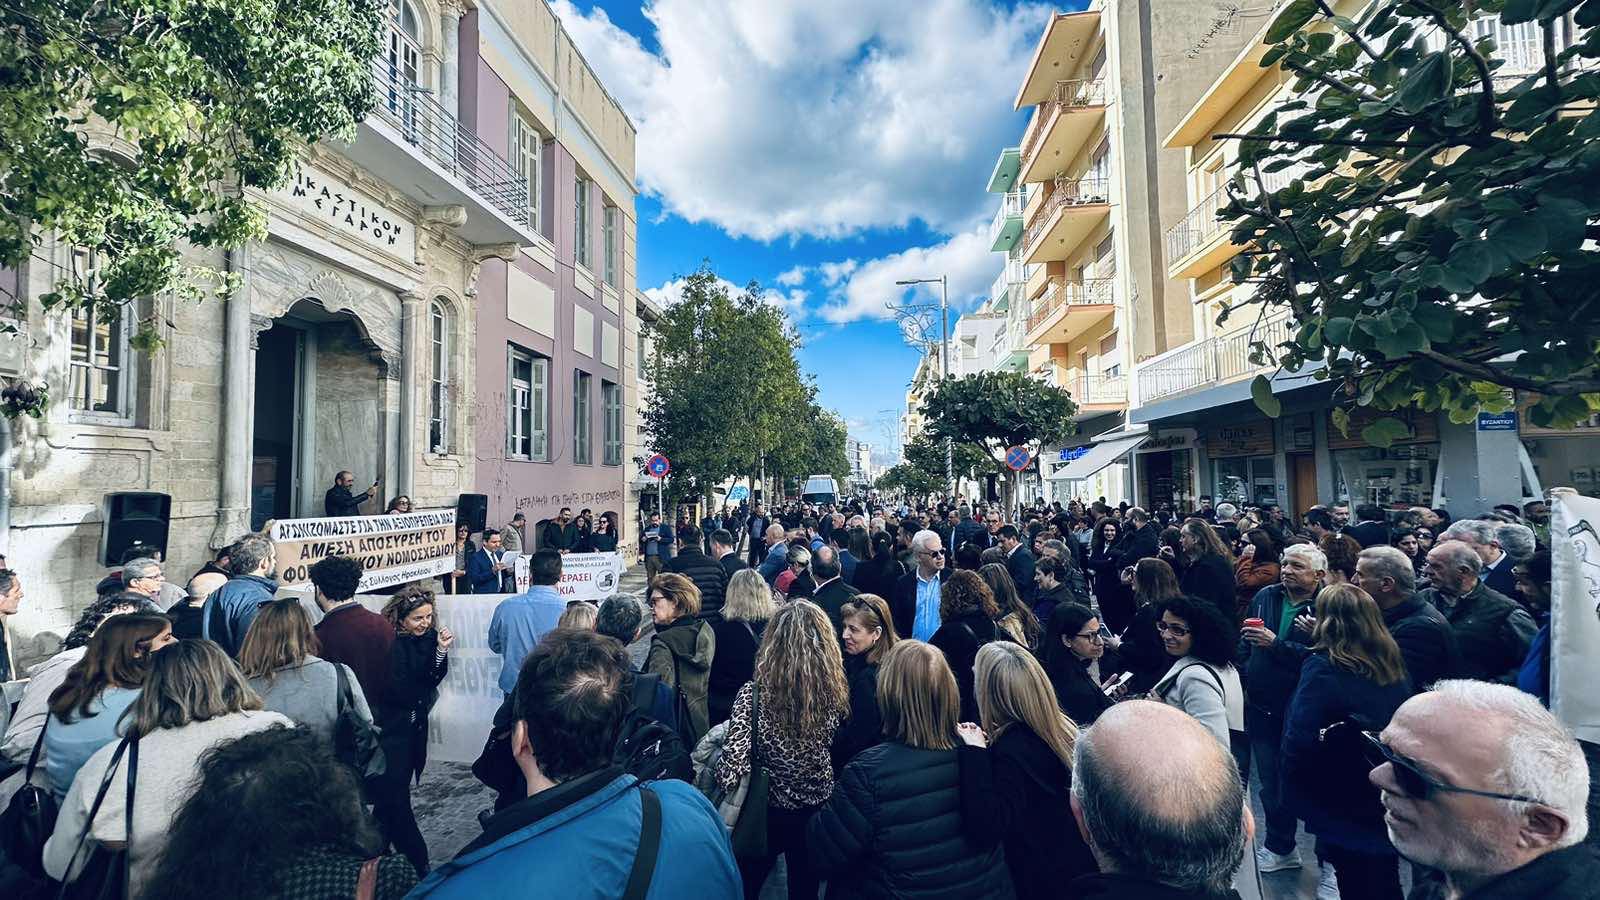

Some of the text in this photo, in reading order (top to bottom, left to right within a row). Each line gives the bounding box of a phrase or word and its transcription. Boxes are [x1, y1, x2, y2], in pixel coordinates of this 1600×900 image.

[292, 185, 396, 245] ΜΕΓΑΡΟΝ
[297, 173, 401, 235] ΙΚΑΣΤΙΚΟΝ
[279, 512, 454, 540] ΑΓΩΝΙΖΟΜΑΣΤΕ ΓΙΑ ΤΗΝ ΑΞΙΟΠΡΕΠΕΙΑ ΜΑΣ
[300, 529, 447, 560] ΑΜΕΣΗ ΑΠΟΣΥΡΣΗ ΤΟΥ
[386, 542, 456, 567] ΝΟΜΟΣΧΕΔΙΟΥ
[559, 585, 576, 595] ΚΙΑ
[561, 572, 592, 583] ΕΡΑΣΕΙ
